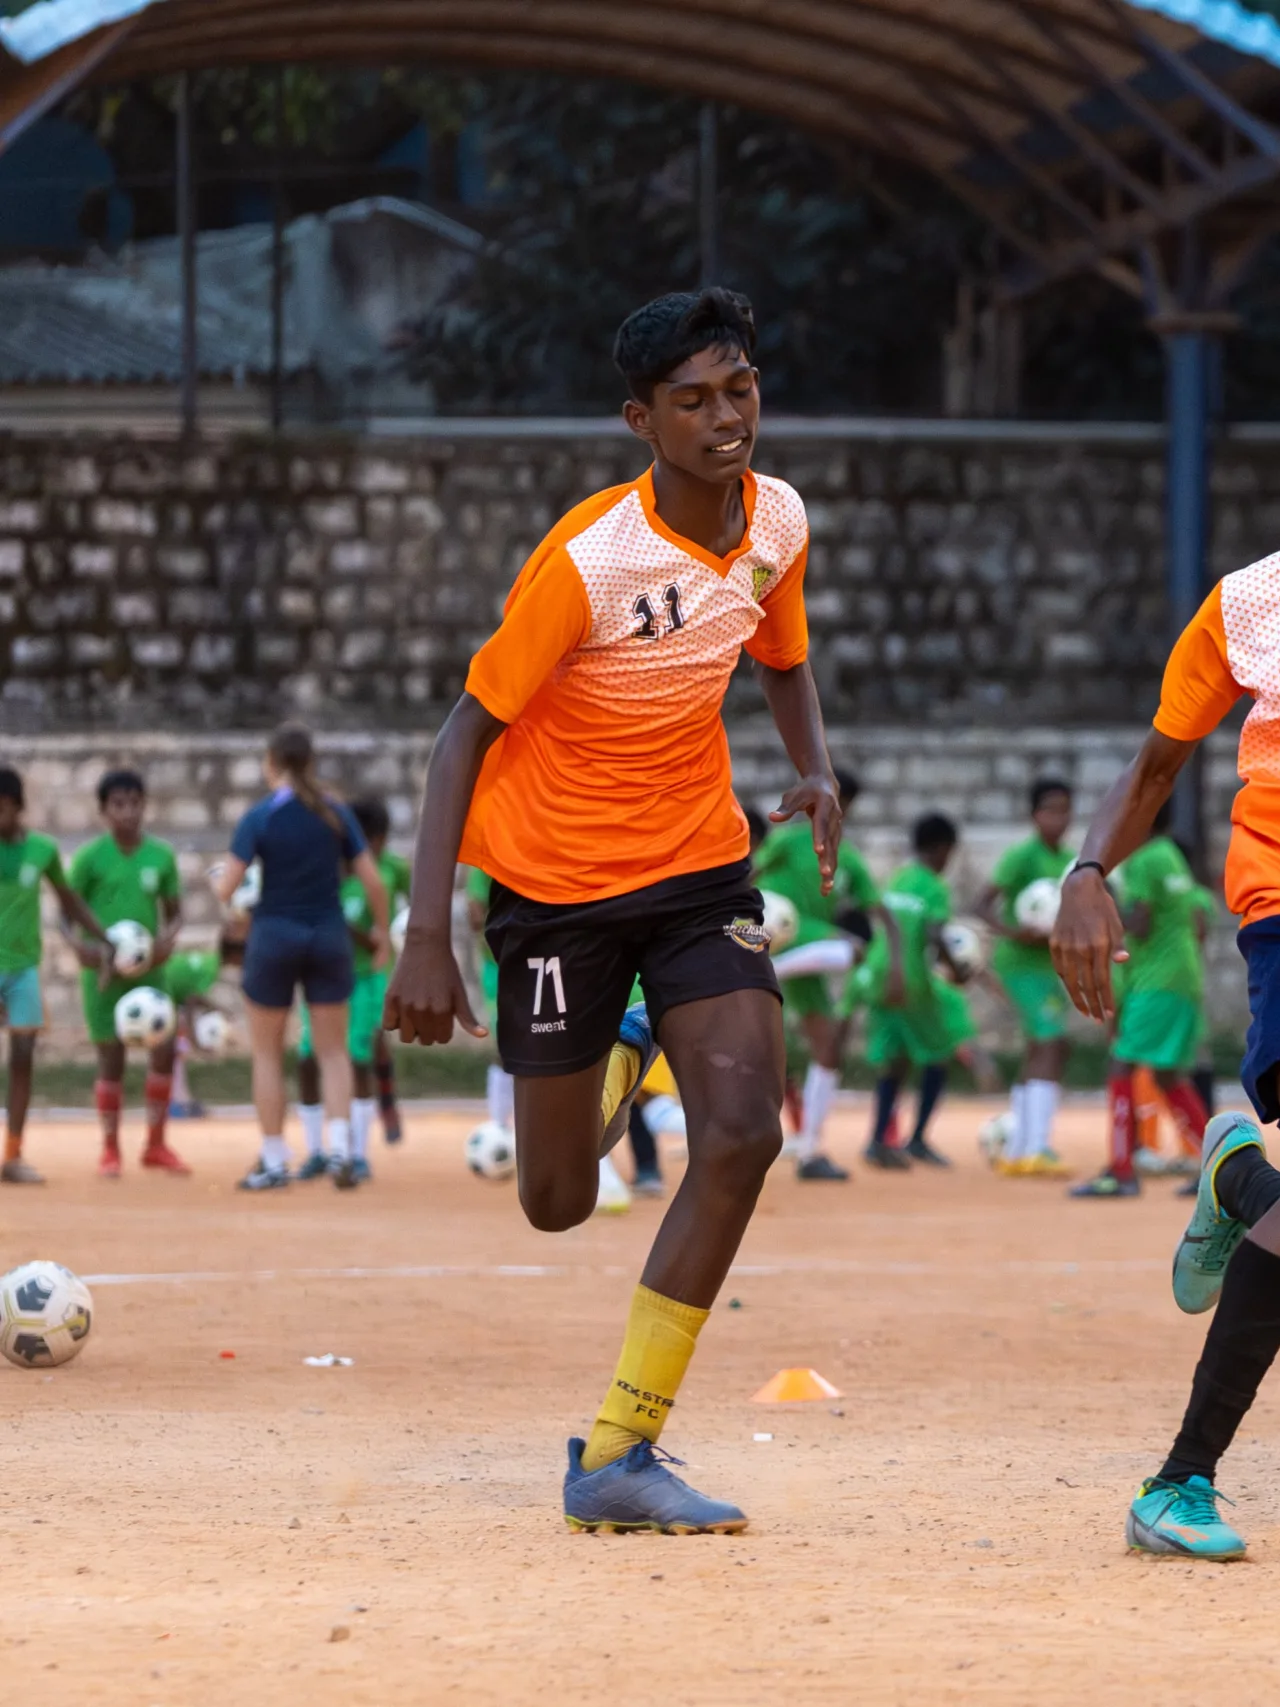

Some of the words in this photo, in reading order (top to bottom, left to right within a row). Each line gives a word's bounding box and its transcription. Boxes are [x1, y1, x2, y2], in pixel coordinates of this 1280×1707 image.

[632, 581, 684, 640] 11
[527, 956, 567, 1015] 71
[531, 1020, 567, 1033] sweat
[635, 1404, 660, 1419] FC
